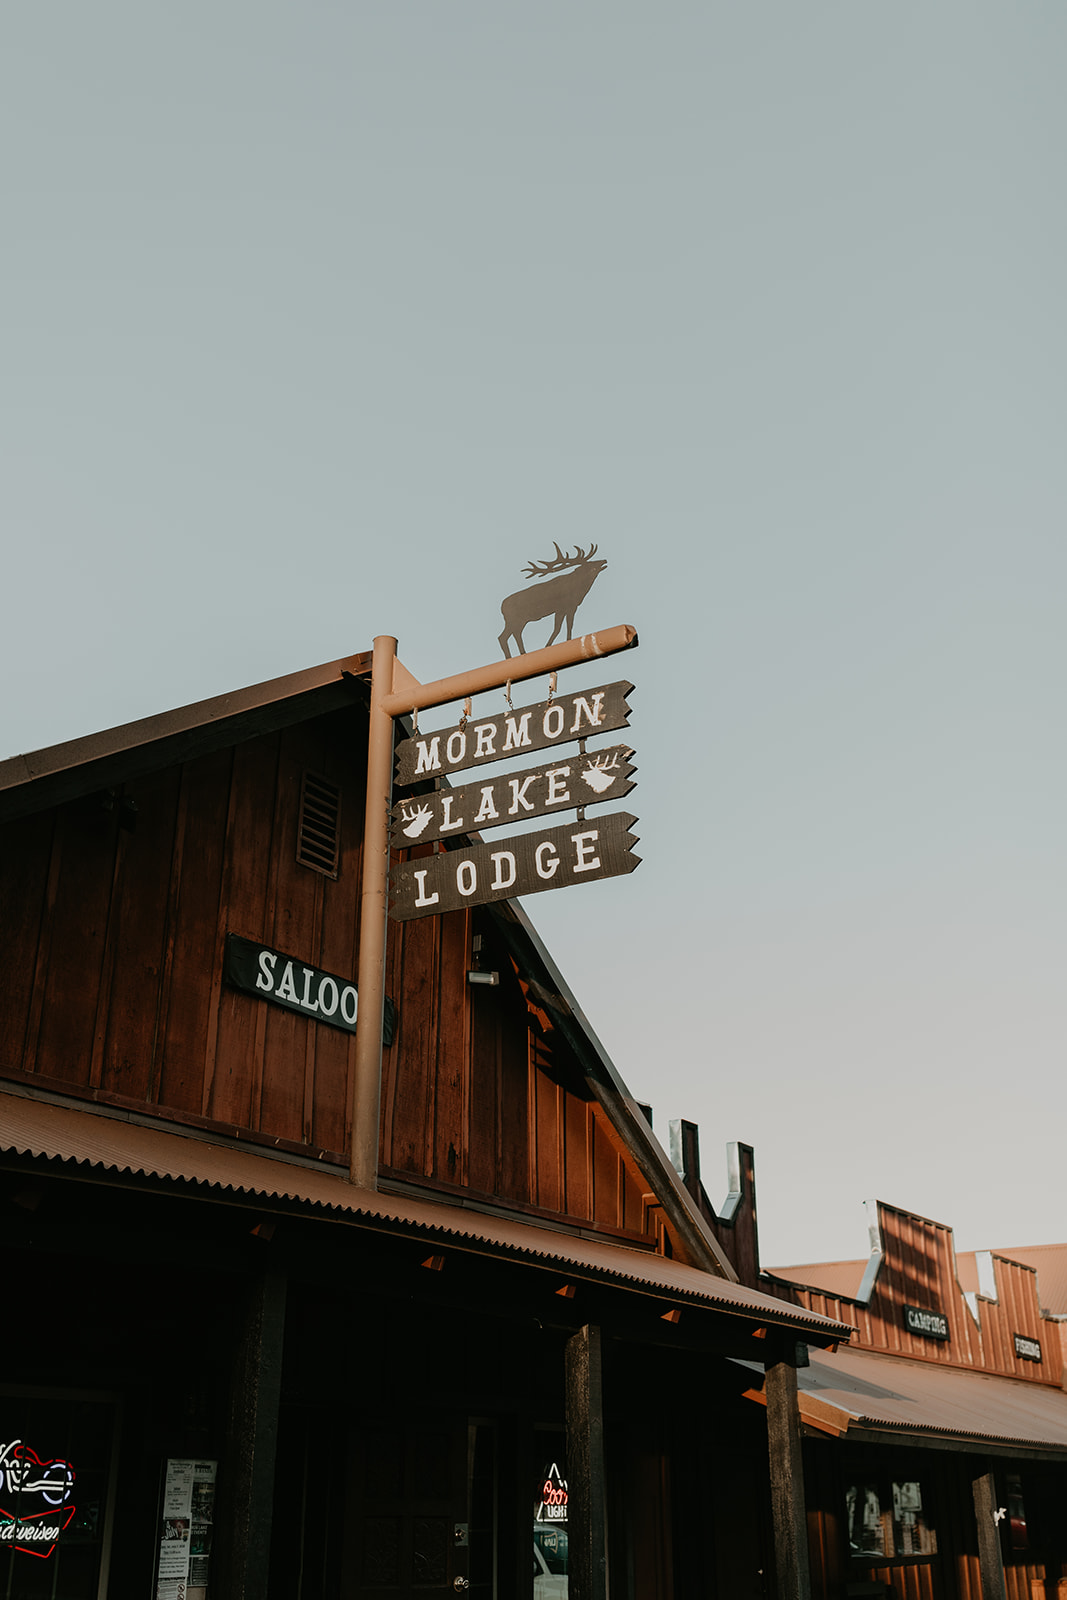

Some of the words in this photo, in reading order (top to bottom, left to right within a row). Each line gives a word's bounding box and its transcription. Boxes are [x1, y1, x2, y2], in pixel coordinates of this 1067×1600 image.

[414, 692, 606, 775] MORMON
[439, 765, 572, 832] LAKE
[413, 829, 602, 908] LODGE
[255, 950, 358, 1024] SALOO
[908, 1310, 947, 1335] CAMPING
